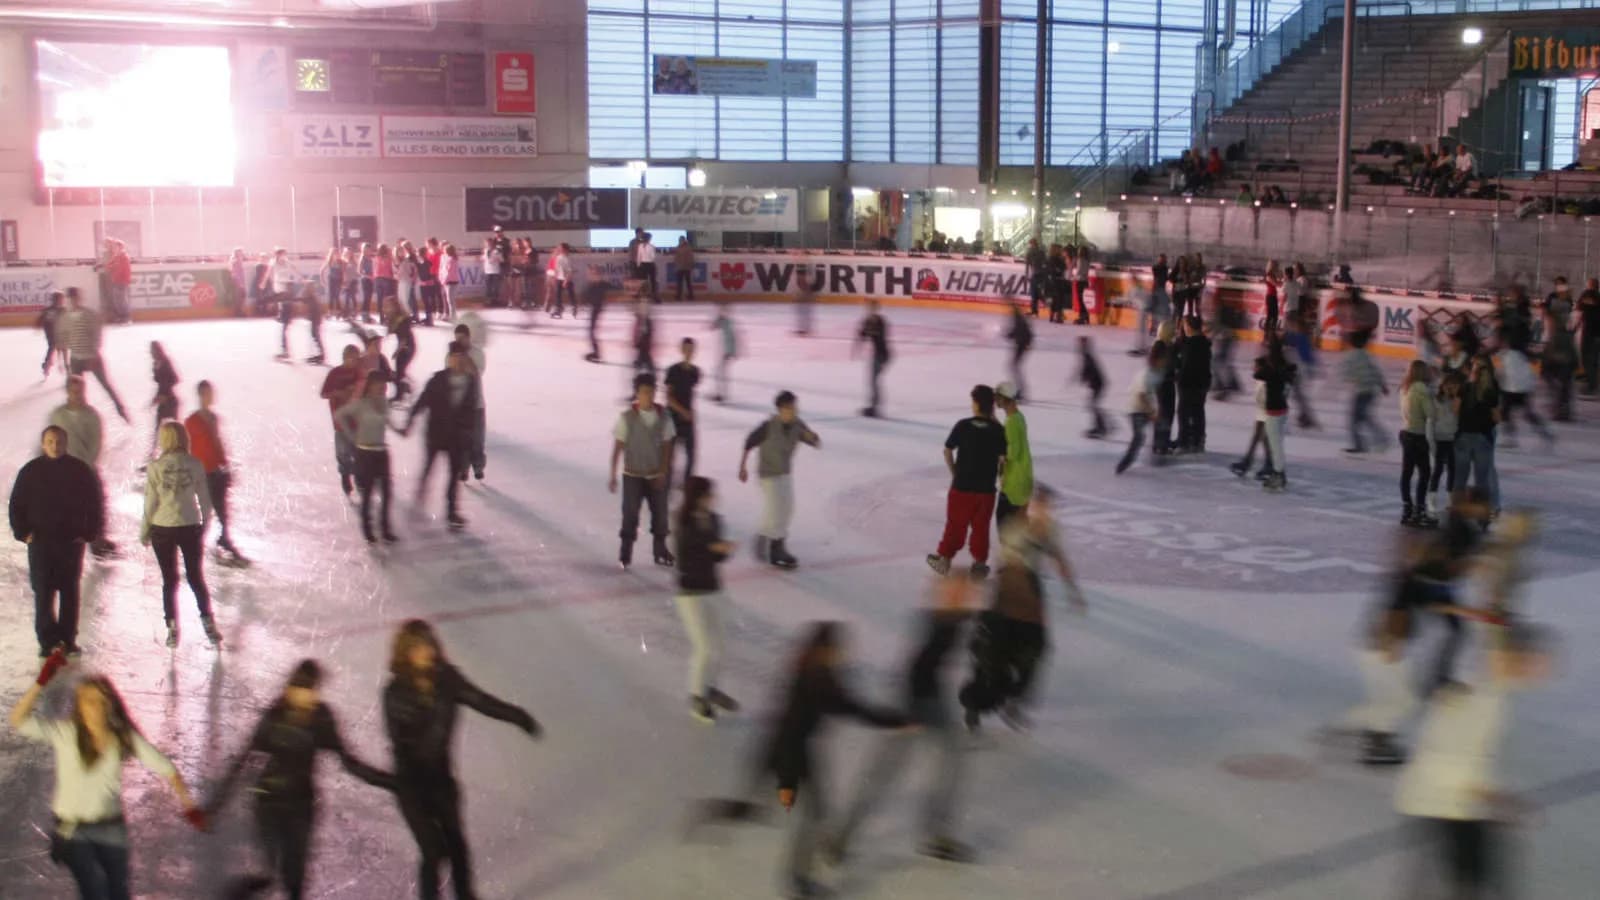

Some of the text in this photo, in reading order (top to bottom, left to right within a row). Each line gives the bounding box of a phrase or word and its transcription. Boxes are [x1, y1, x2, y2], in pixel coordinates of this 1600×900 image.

[388, 143, 428, 154] ALLES
[431, 143, 468, 154] RUND
[503, 144, 536, 154] GLAS
[493, 190, 600, 221] smart
[639, 194, 759, 215] LAVATEC
[753, 262, 913, 295] WÜRTH
[1385, 305, 1414, 329] MK
